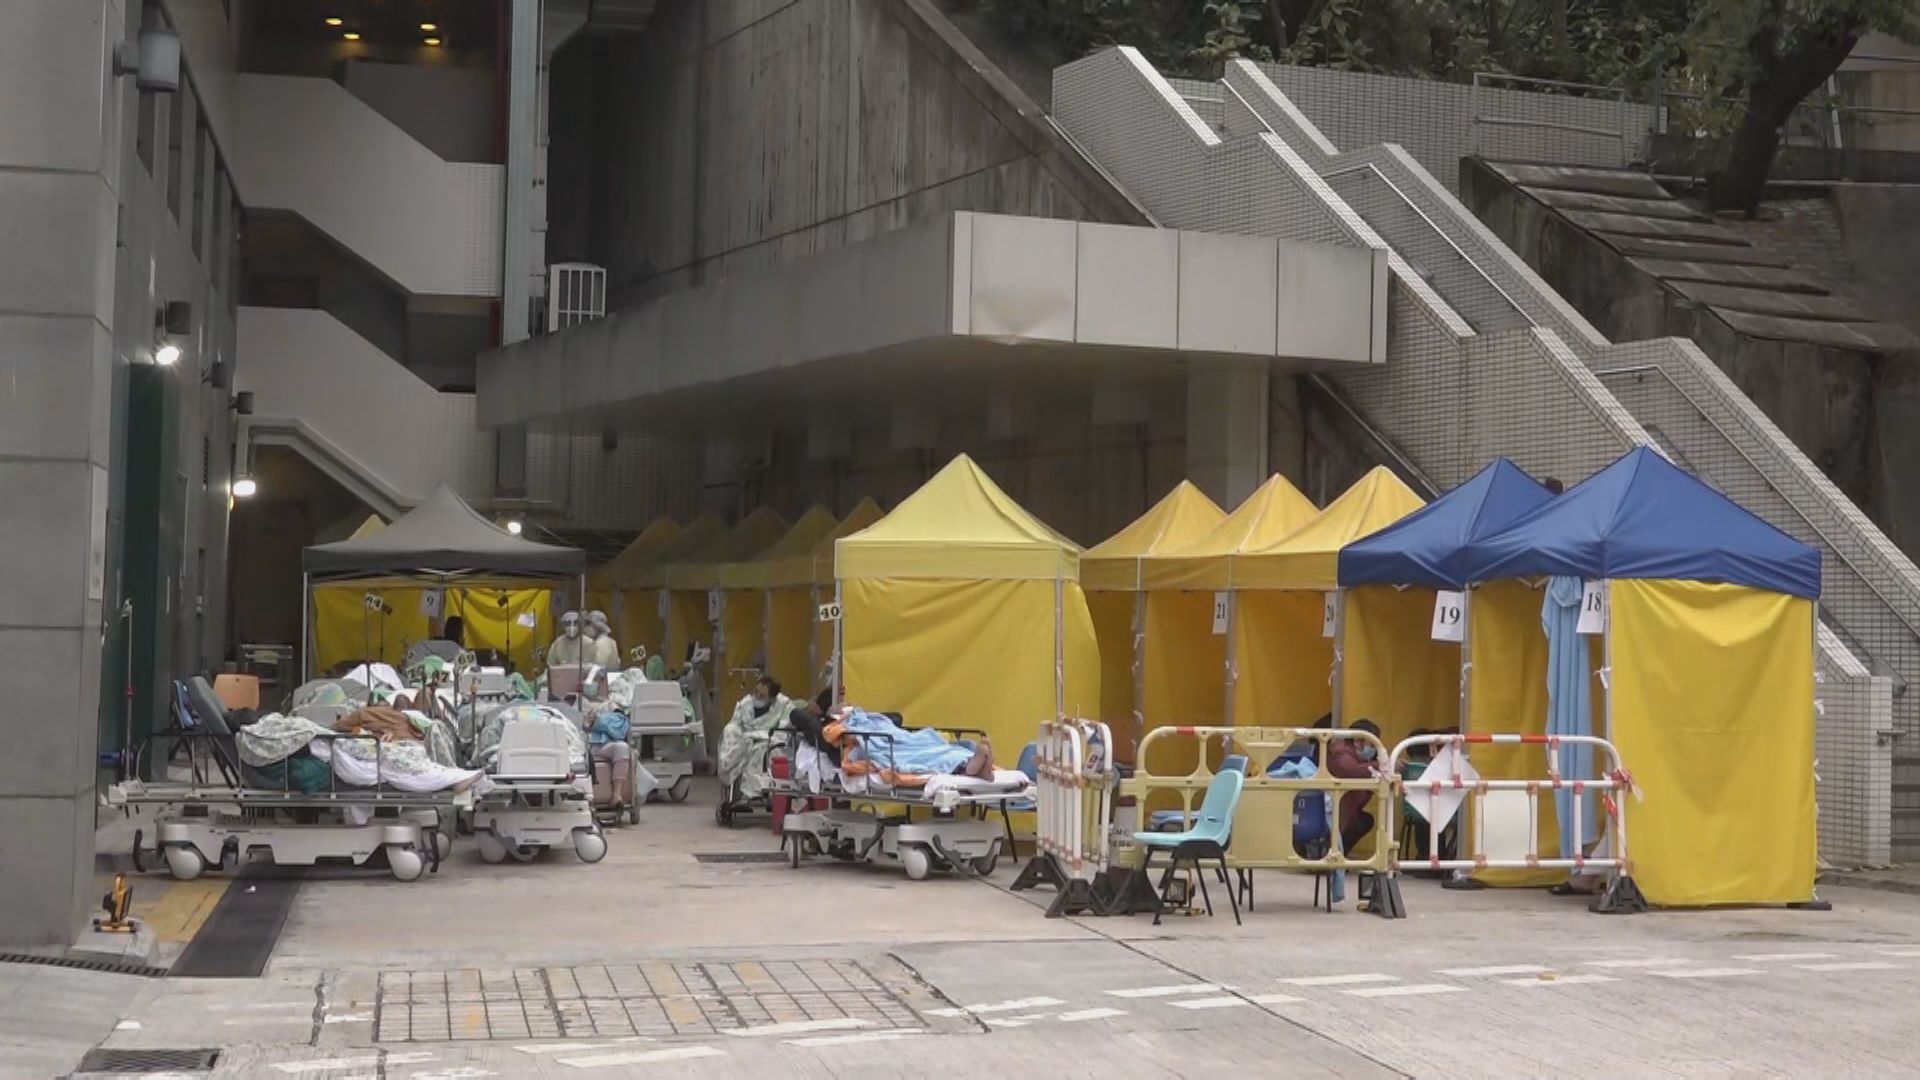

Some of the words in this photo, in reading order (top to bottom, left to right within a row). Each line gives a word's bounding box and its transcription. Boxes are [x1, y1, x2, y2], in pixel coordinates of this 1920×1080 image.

[427, 596, 434, 606] 9
[1586, 592, 1602, 611] 18
[820, 606, 839, 619] 40
[1216, 603, 1225, 619] 21
[1440, 606, 1461, 624] 19
